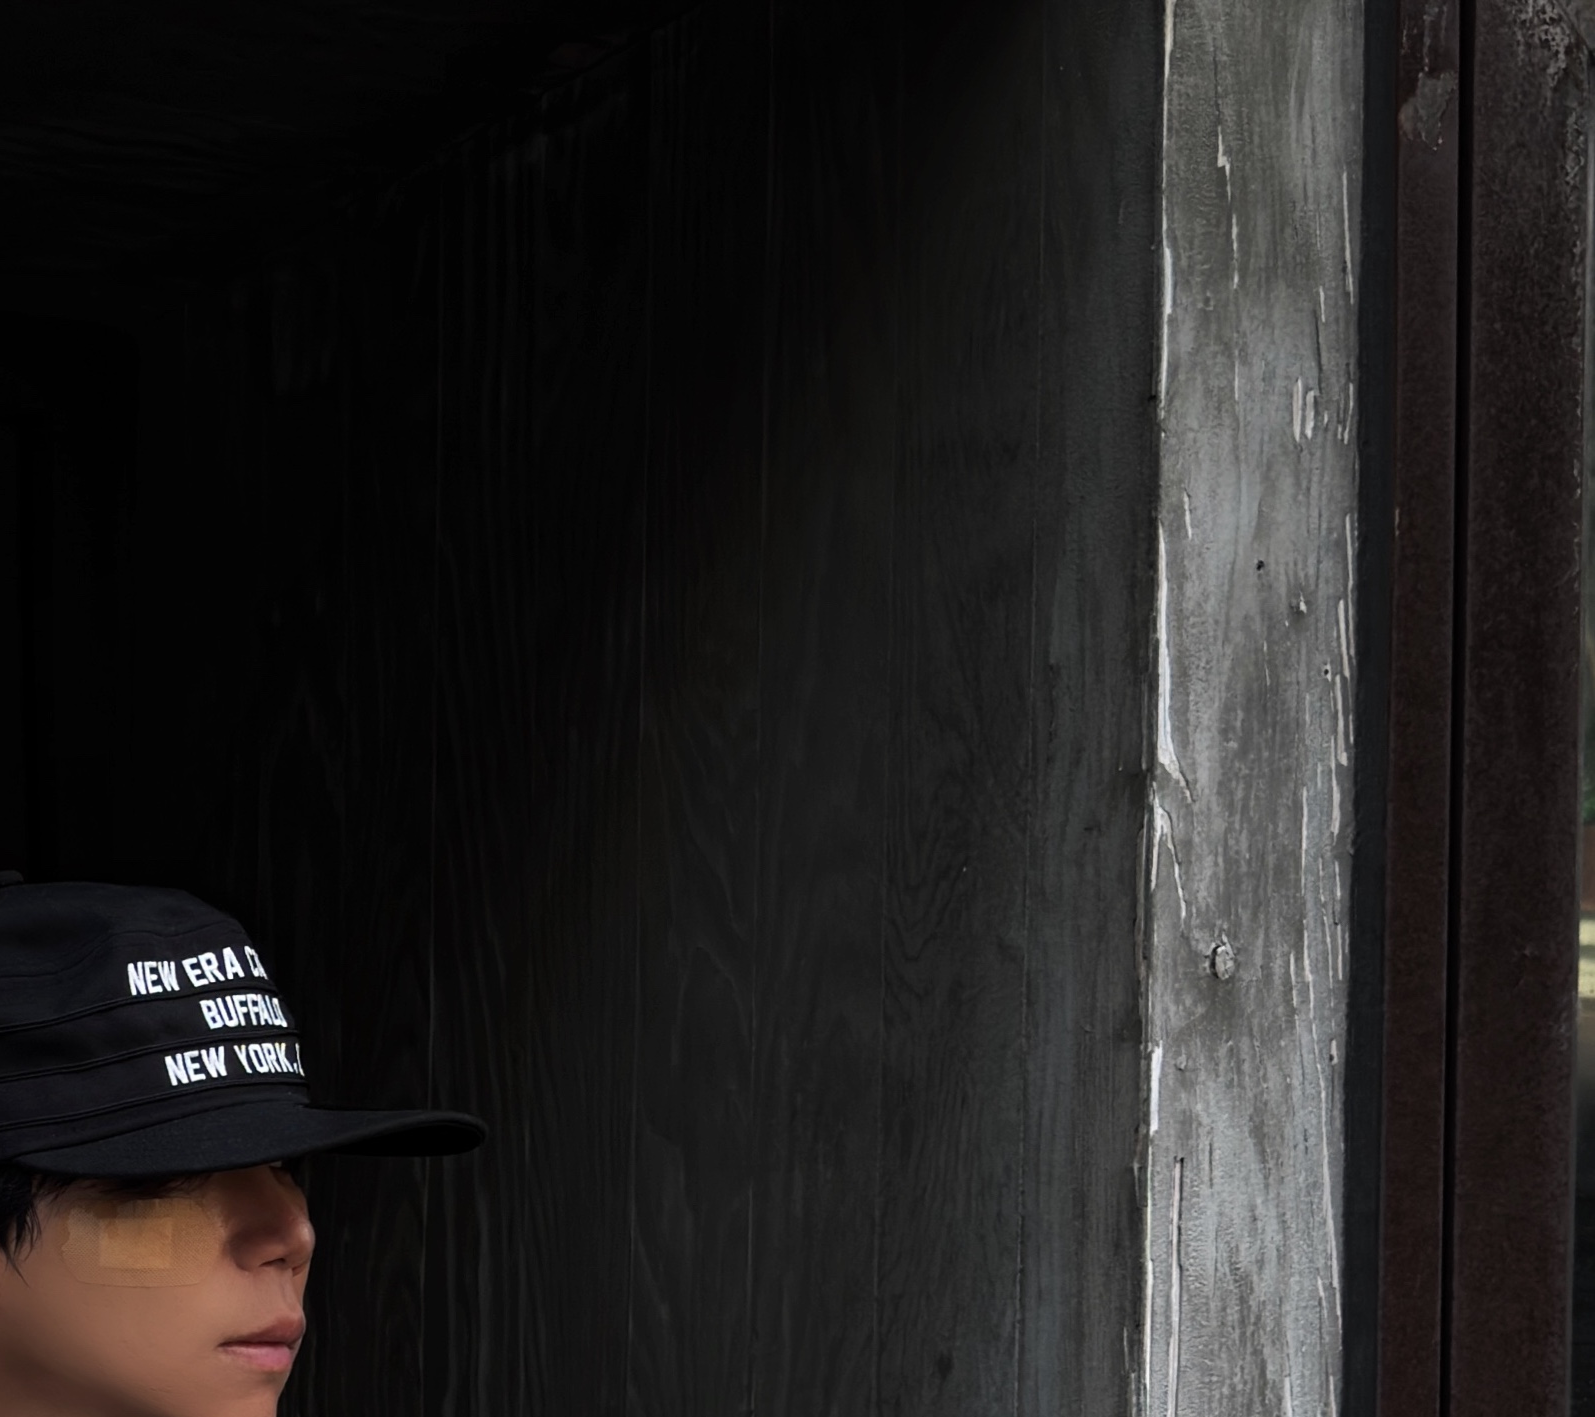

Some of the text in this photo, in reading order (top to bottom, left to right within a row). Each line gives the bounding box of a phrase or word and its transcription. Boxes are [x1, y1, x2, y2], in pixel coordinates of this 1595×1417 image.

[127, 960, 180, 996] NEW
[182, 946, 245, 988] ERA
[164, 1045, 228, 1087] NEW
